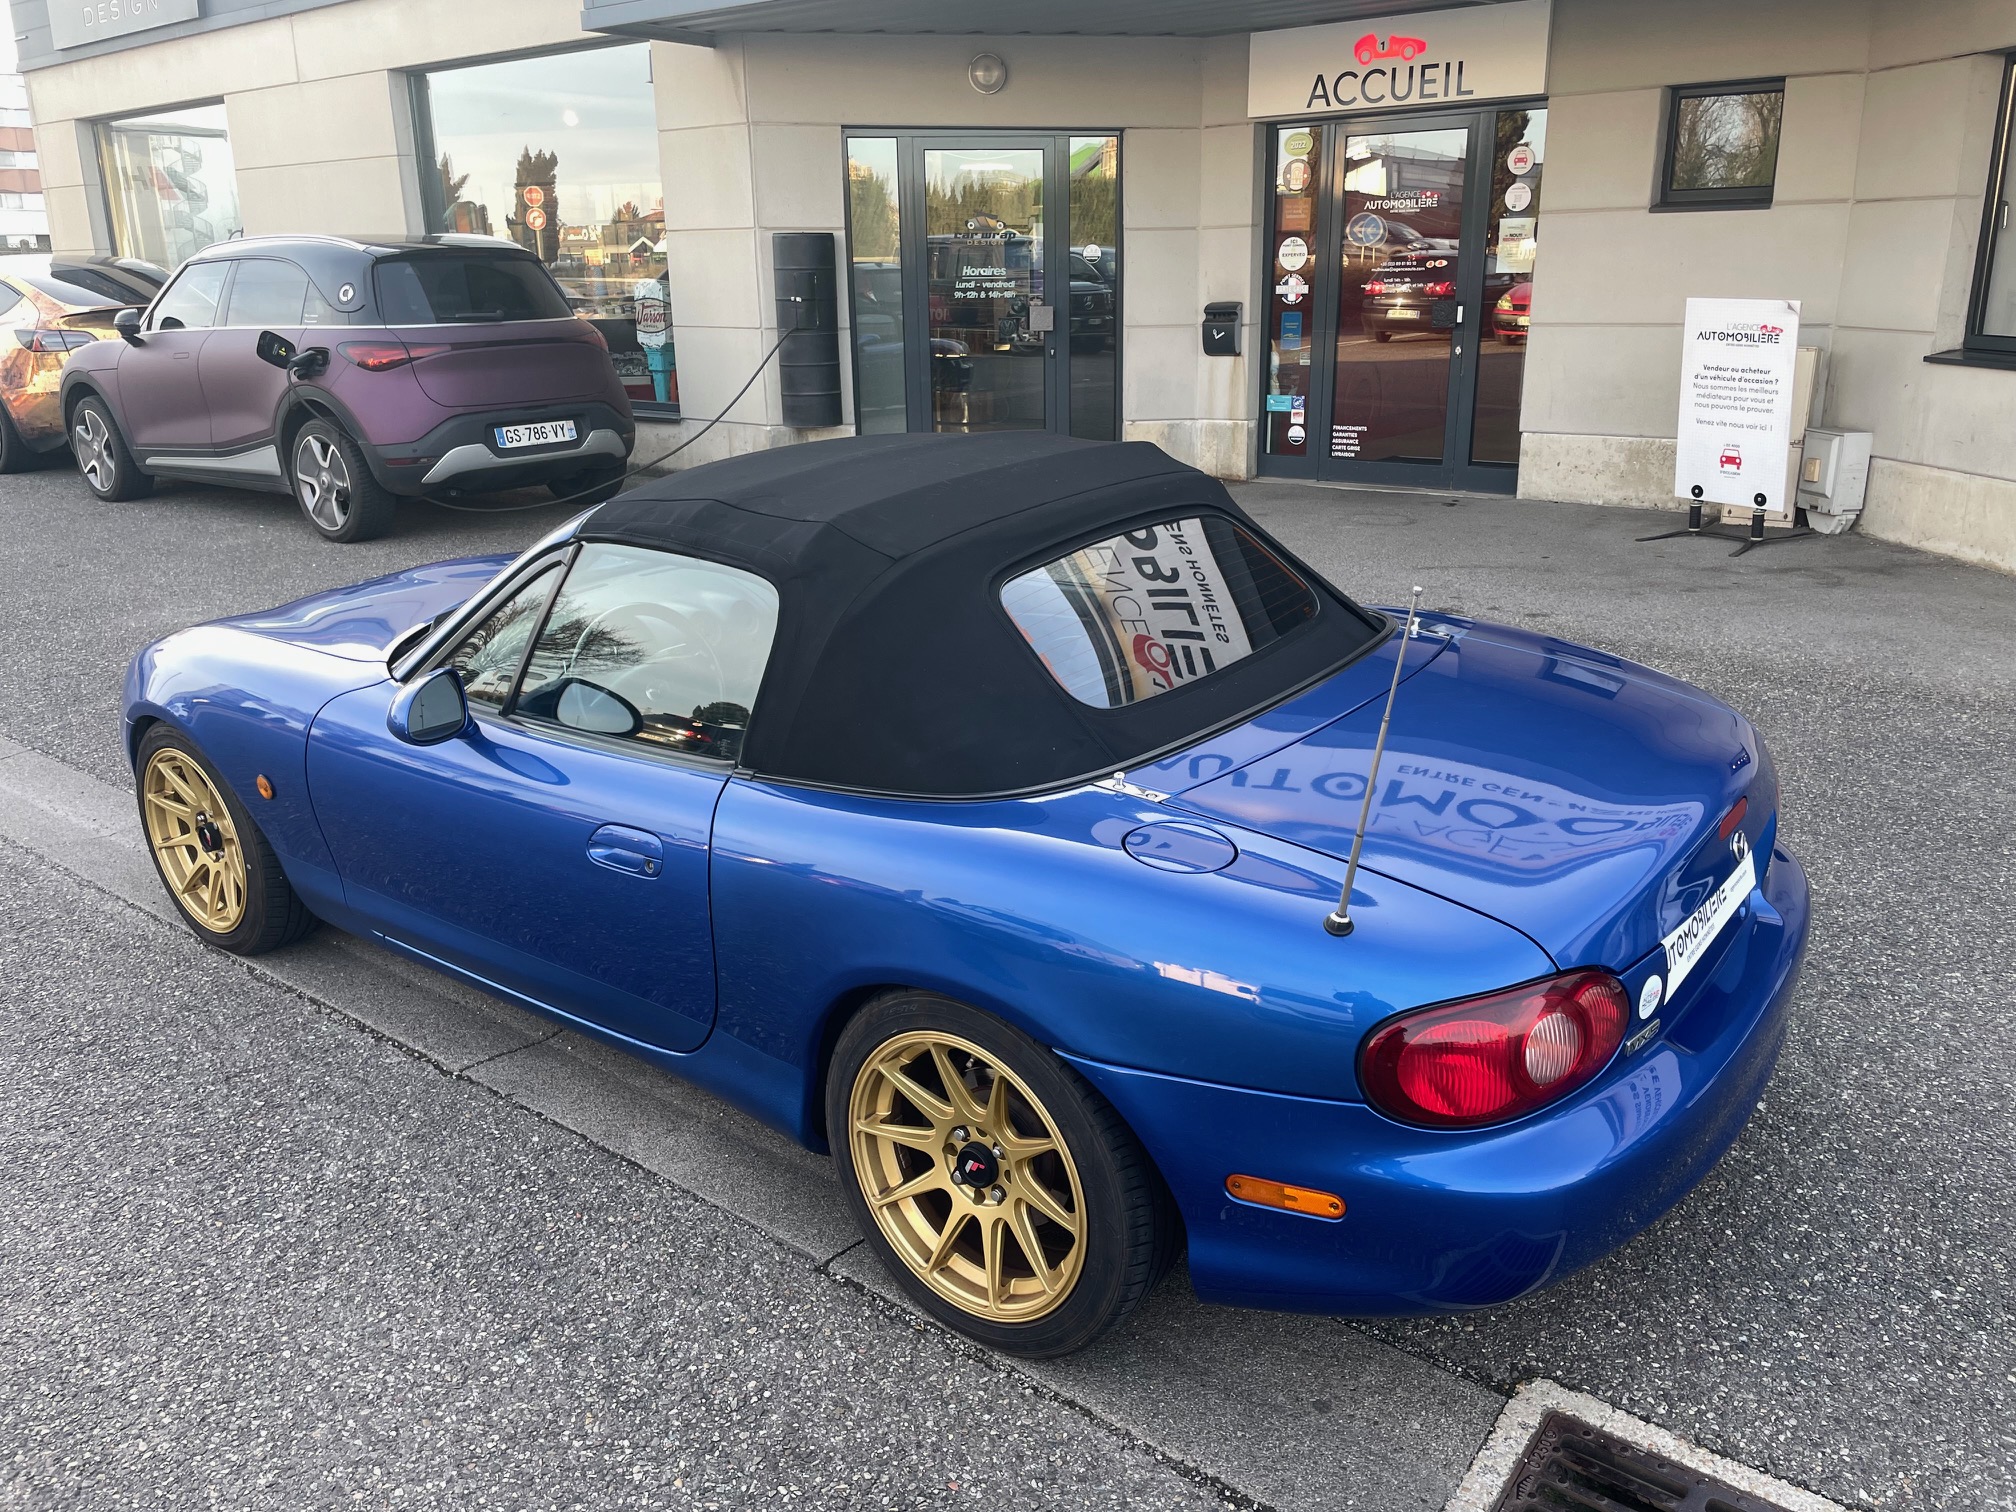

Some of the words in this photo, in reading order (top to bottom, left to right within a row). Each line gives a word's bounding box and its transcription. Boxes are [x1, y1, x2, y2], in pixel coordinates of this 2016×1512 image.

[82, 0, 158, 27] DESIGN
[1306, 61, 1474, 108] ACCUEIL
[962, 266, 1006, 276] Horaires
[1726, 323, 1761, 331] L'AGENCE
[1703, 364, 1730, 372] Vendeur
[1741, 367, 1771, 375] acheteur
[1710, 374, 1736, 382] véhicule
[1738, 376, 1773, 384] d'occasion
[1749, 387, 1779, 395] meilleurs
[1696, 392, 1732, 401] médiateurs
[1696, 417, 1714, 425] Venez
